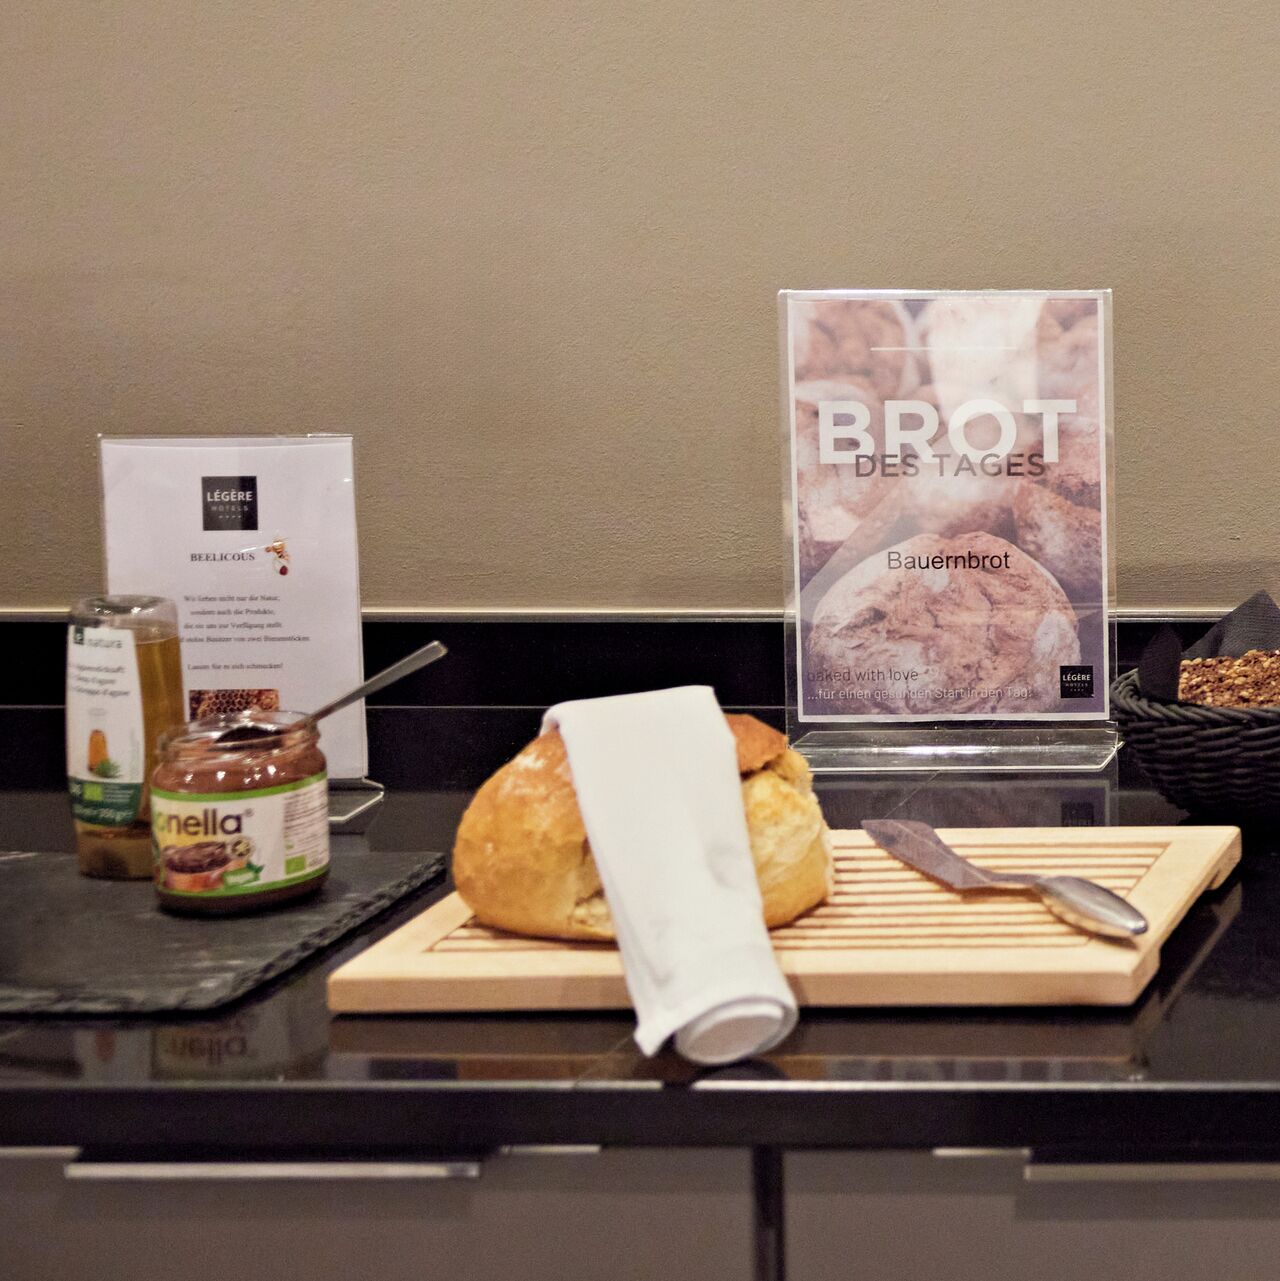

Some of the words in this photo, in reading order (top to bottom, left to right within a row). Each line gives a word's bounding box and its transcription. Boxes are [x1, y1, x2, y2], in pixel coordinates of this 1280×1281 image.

[818, 398, 1077, 464] BROT
[855, 454, 919, 478] DES
[932, 452, 1045, 477] TAGES
[206, 489, 253, 502] LÉGÈRE
[190, 552, 256, 562] BEELICOUS
[887, 550, 1010, 570] Bauernbrot
[807, 668, 851, 682] baked
[855, 668, 885, 681] with
[889, 668, 919, 681] love
[1062, 672, 1091, 681] LÉGÈRE
[839, 688, 871, 700] einen
[874, 688, 931, 701] gesunden
[935, 687, 964, 699] Start
[967, 687, 977, 699] in
[980, 687, 1003, 699] den
